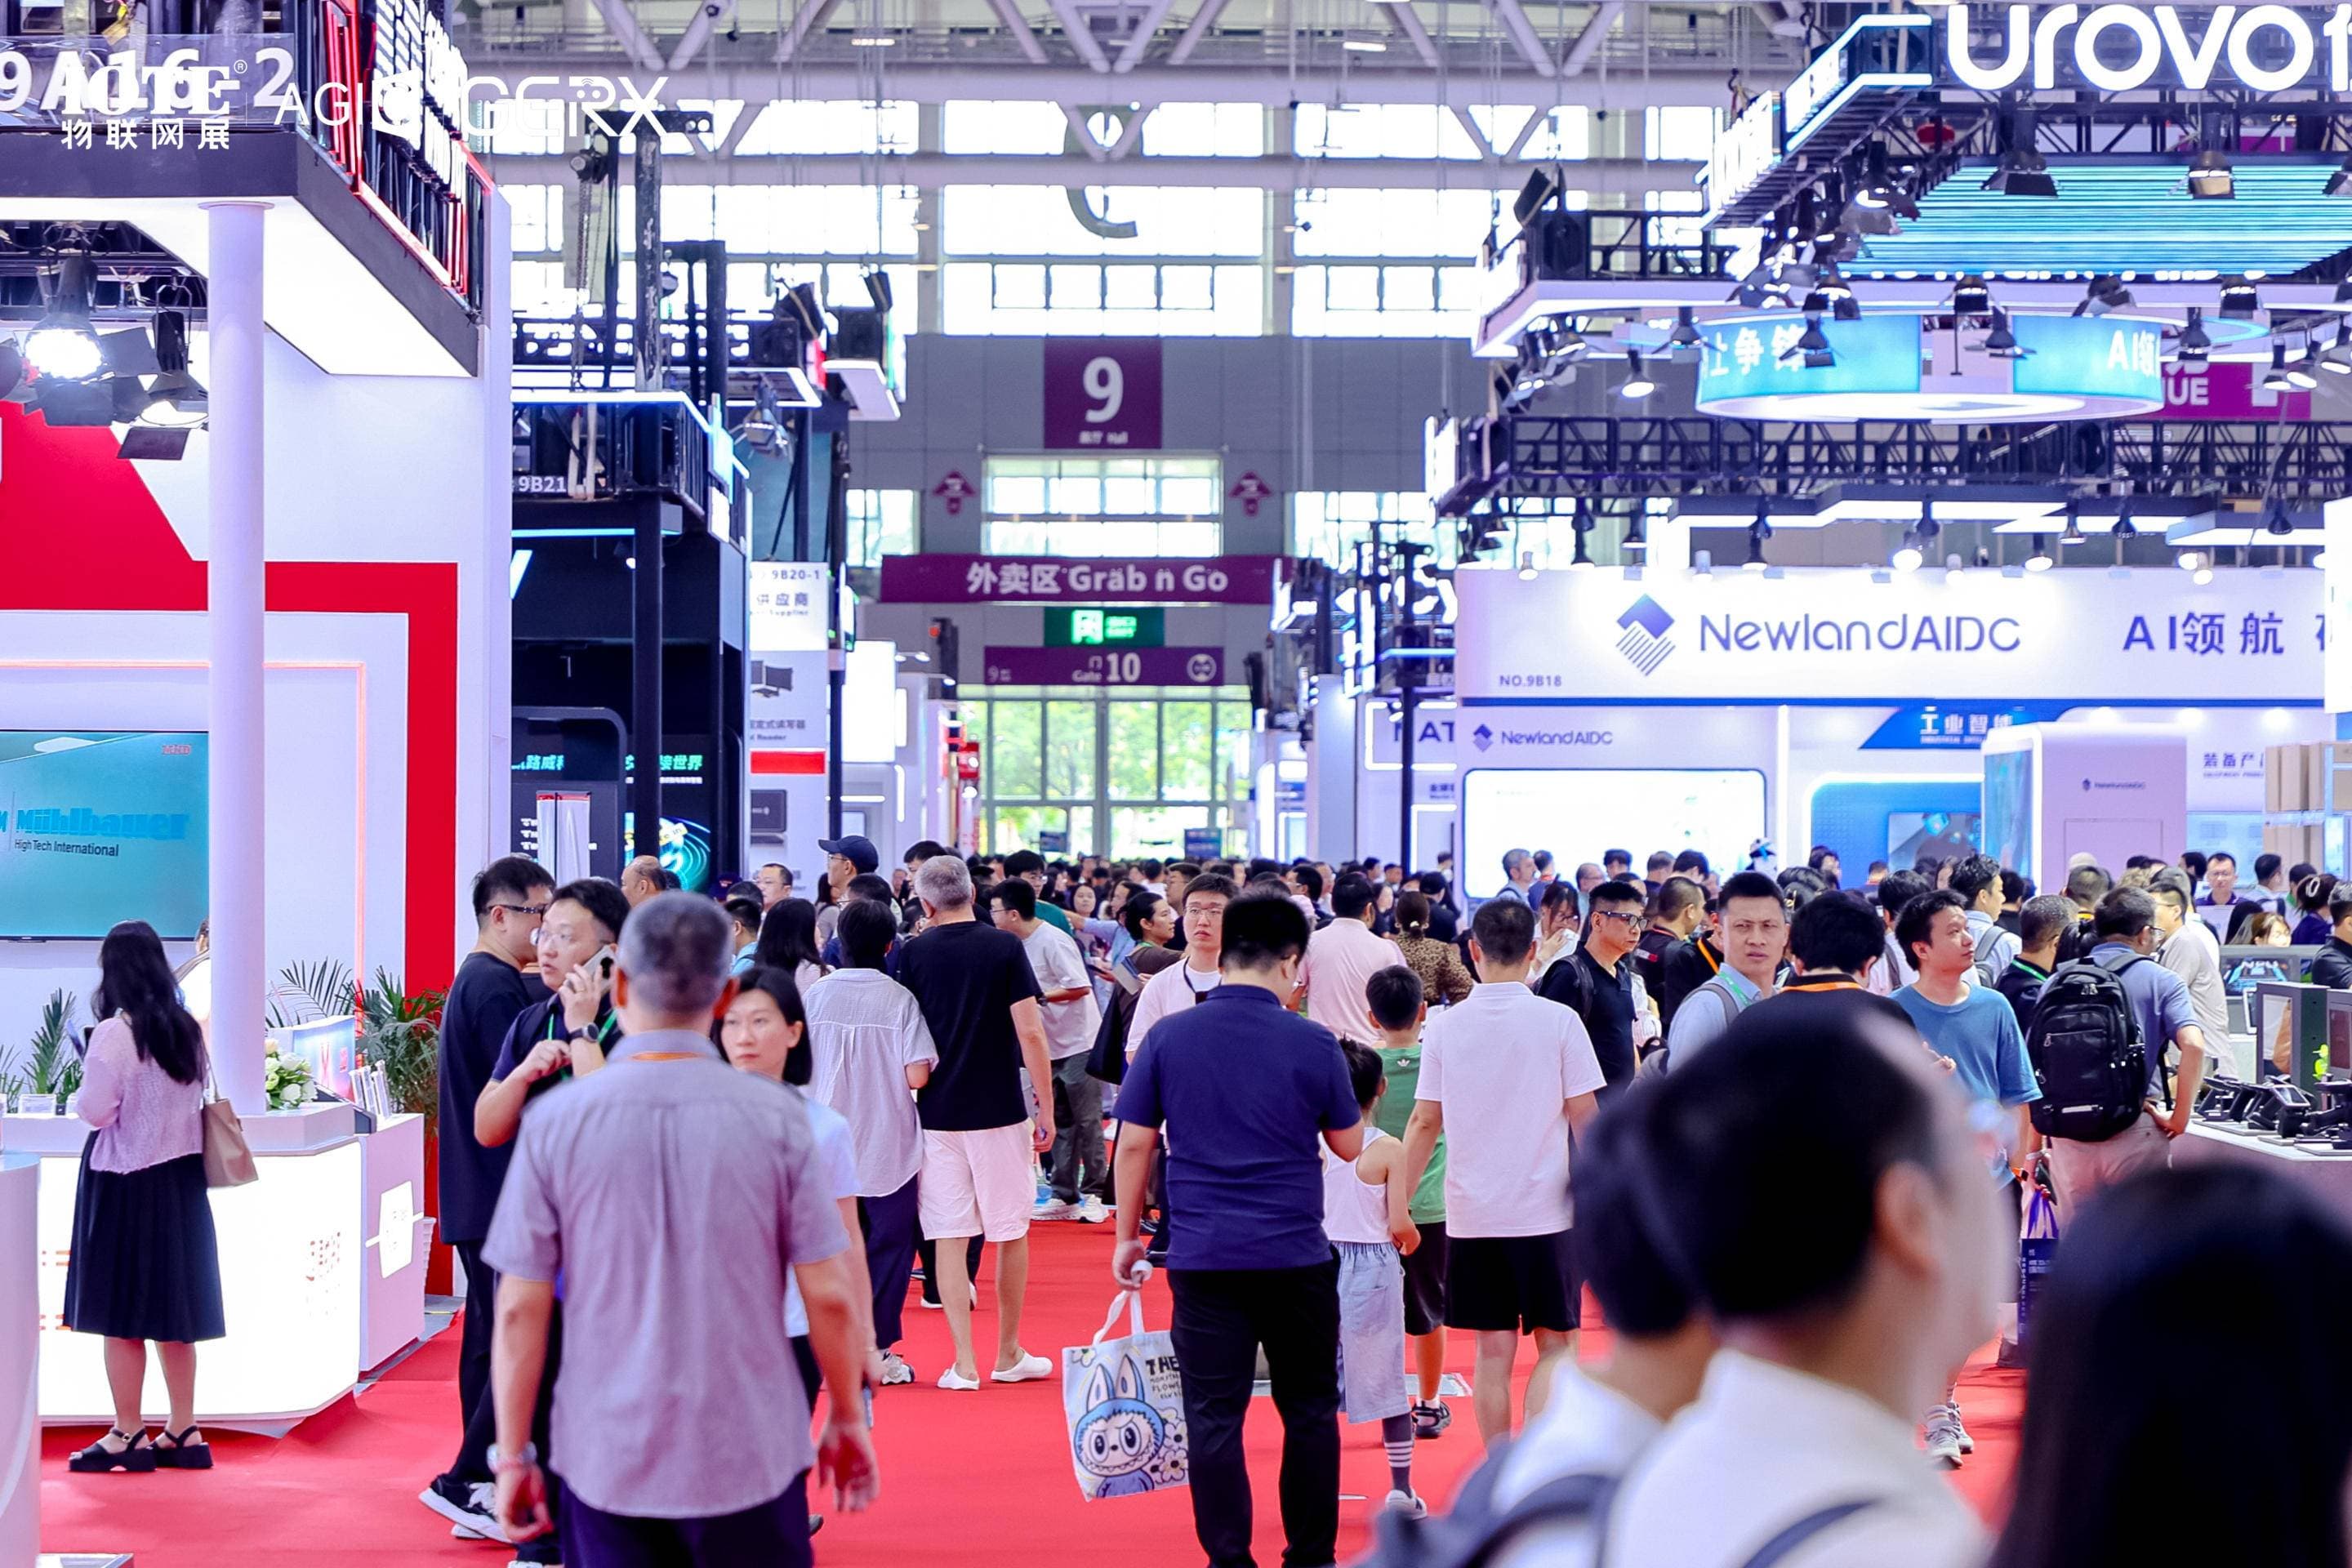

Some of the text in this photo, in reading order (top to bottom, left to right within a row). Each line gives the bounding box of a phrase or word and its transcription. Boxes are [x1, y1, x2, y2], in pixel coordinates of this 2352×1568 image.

[1083, 356, 1125, 423] 9
[2163, 376, 2210, 406] UE
[967, 562, 1228, 595] 外卖区 Grab n Go
[1699, 612, 2021, 652] NewlandAIDC
[1071, 653, 1142, 683] Gate 10
[1499, 675, 1562, 688] NO.9B18
[1501, 728, 1614, 746] NewlandAIDC
[15, 839, 120, 857] High Tech International
[1145, 1355, 1181, 1376] THE
